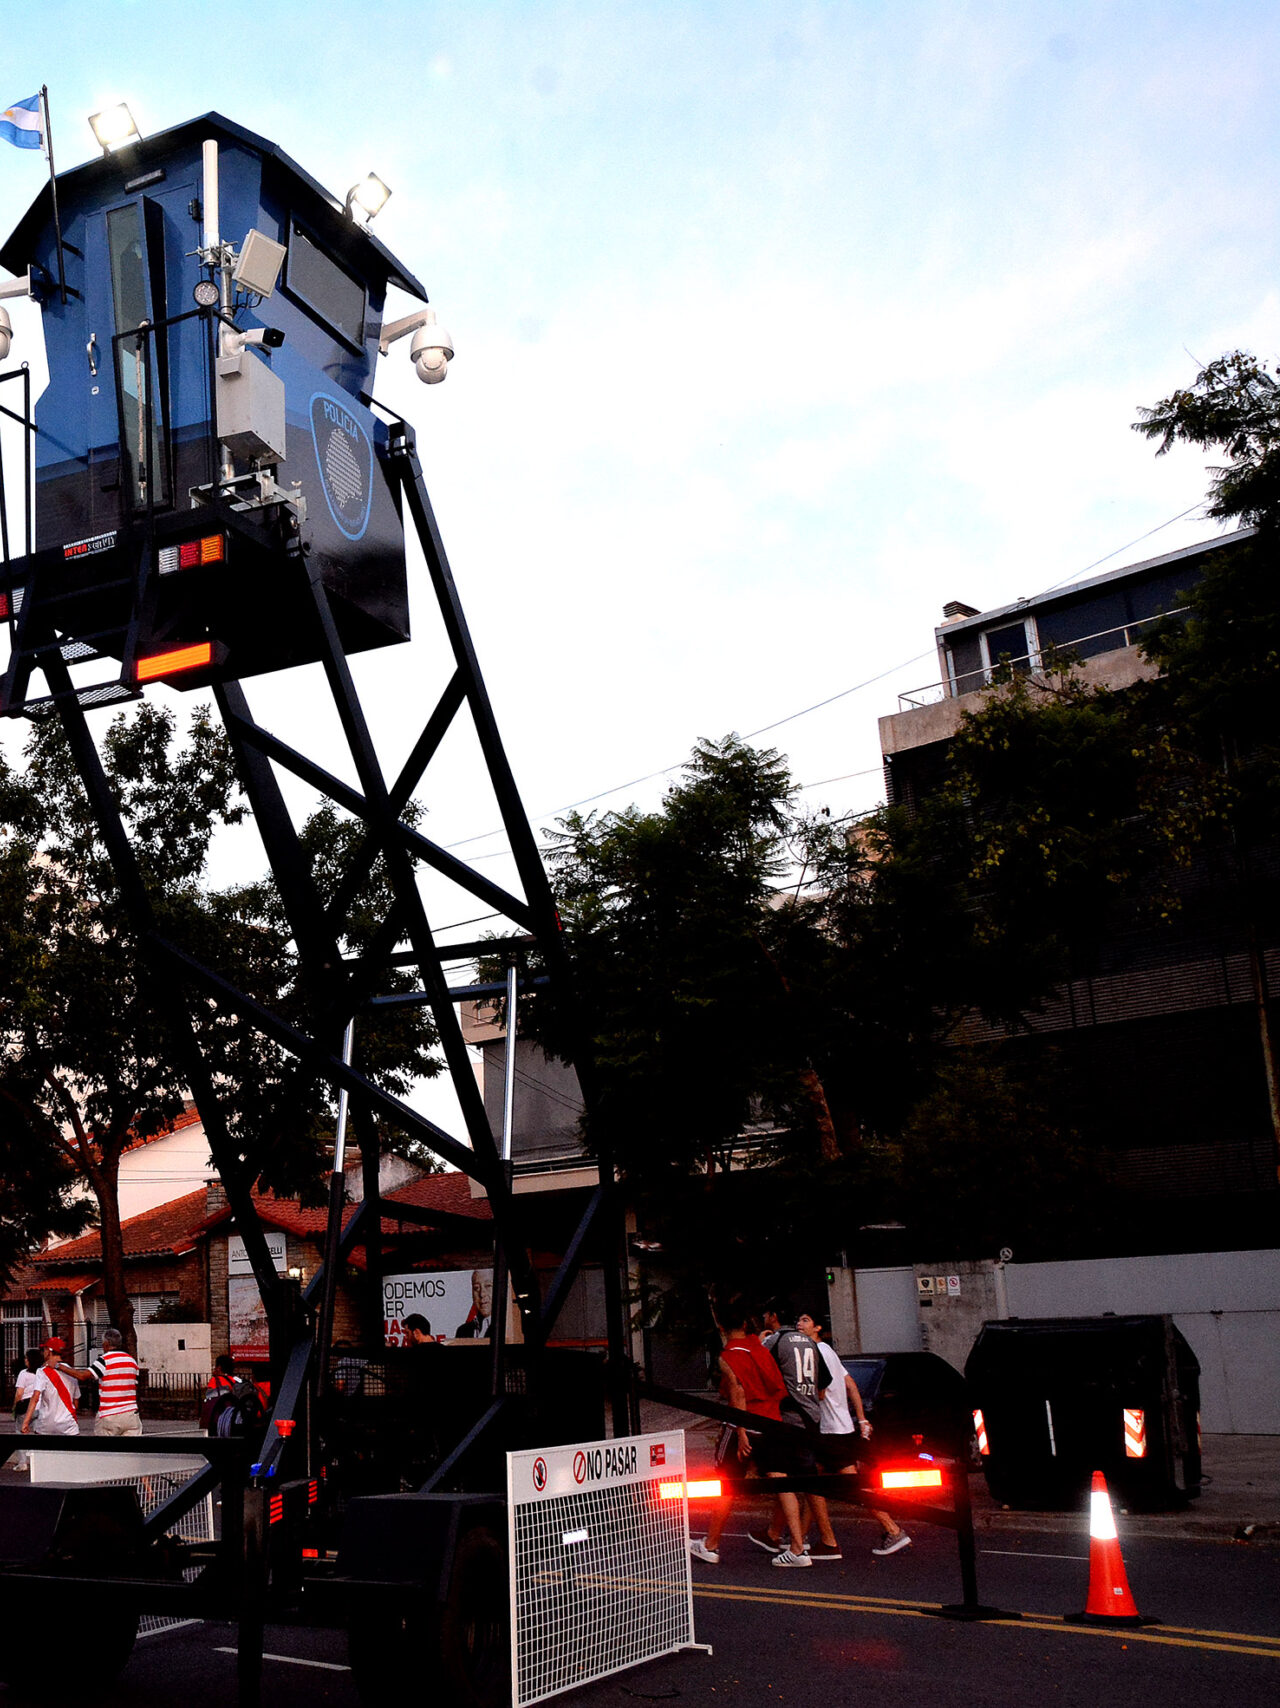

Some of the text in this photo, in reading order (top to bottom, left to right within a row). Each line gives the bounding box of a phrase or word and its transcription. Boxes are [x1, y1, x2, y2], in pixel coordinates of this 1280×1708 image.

[323, 400, 359, 442] POLICIA
[384, 1280, 445, 1299] ODEMOS
[384, 1301, 405, 1318] ER
[793, 1346, 815, 1383] 14
[587, 1446, 637, 1480] NO PASAR
